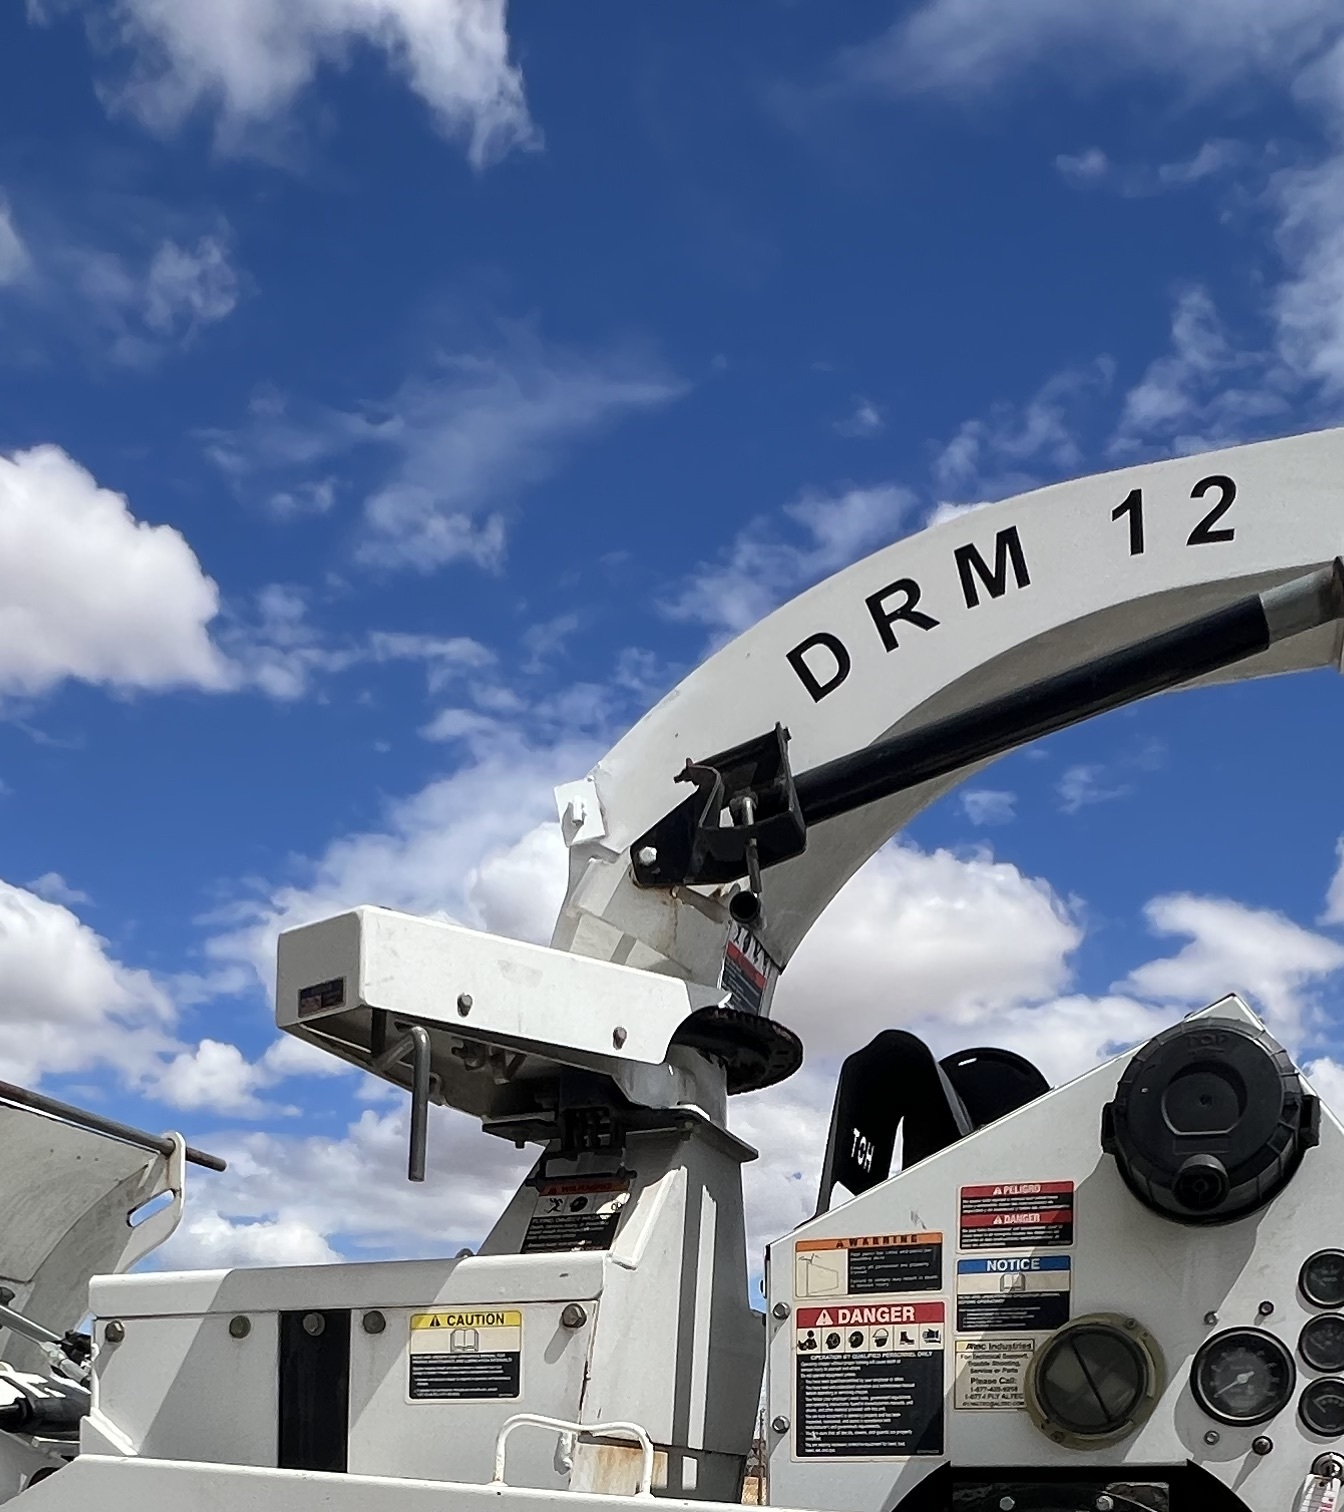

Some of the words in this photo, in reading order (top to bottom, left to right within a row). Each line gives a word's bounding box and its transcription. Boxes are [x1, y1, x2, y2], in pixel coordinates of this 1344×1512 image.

[786, 525, 1031, 703] DRM
[1111, 474, 1237, 557] 12
[1004, 1184, 1041, 1194] PELIGRO
[1004, 1214, 1040, 1224] DANGER
[848, 1234, 918, 1248] WARNING
[987, 1258, 1040, 1271] NOTICE
[447, 1313, 505, 1326] CAUTION
[838, 1306, 915, 1324] DANGER
[989, 1342, 1031, 1350] Industries
